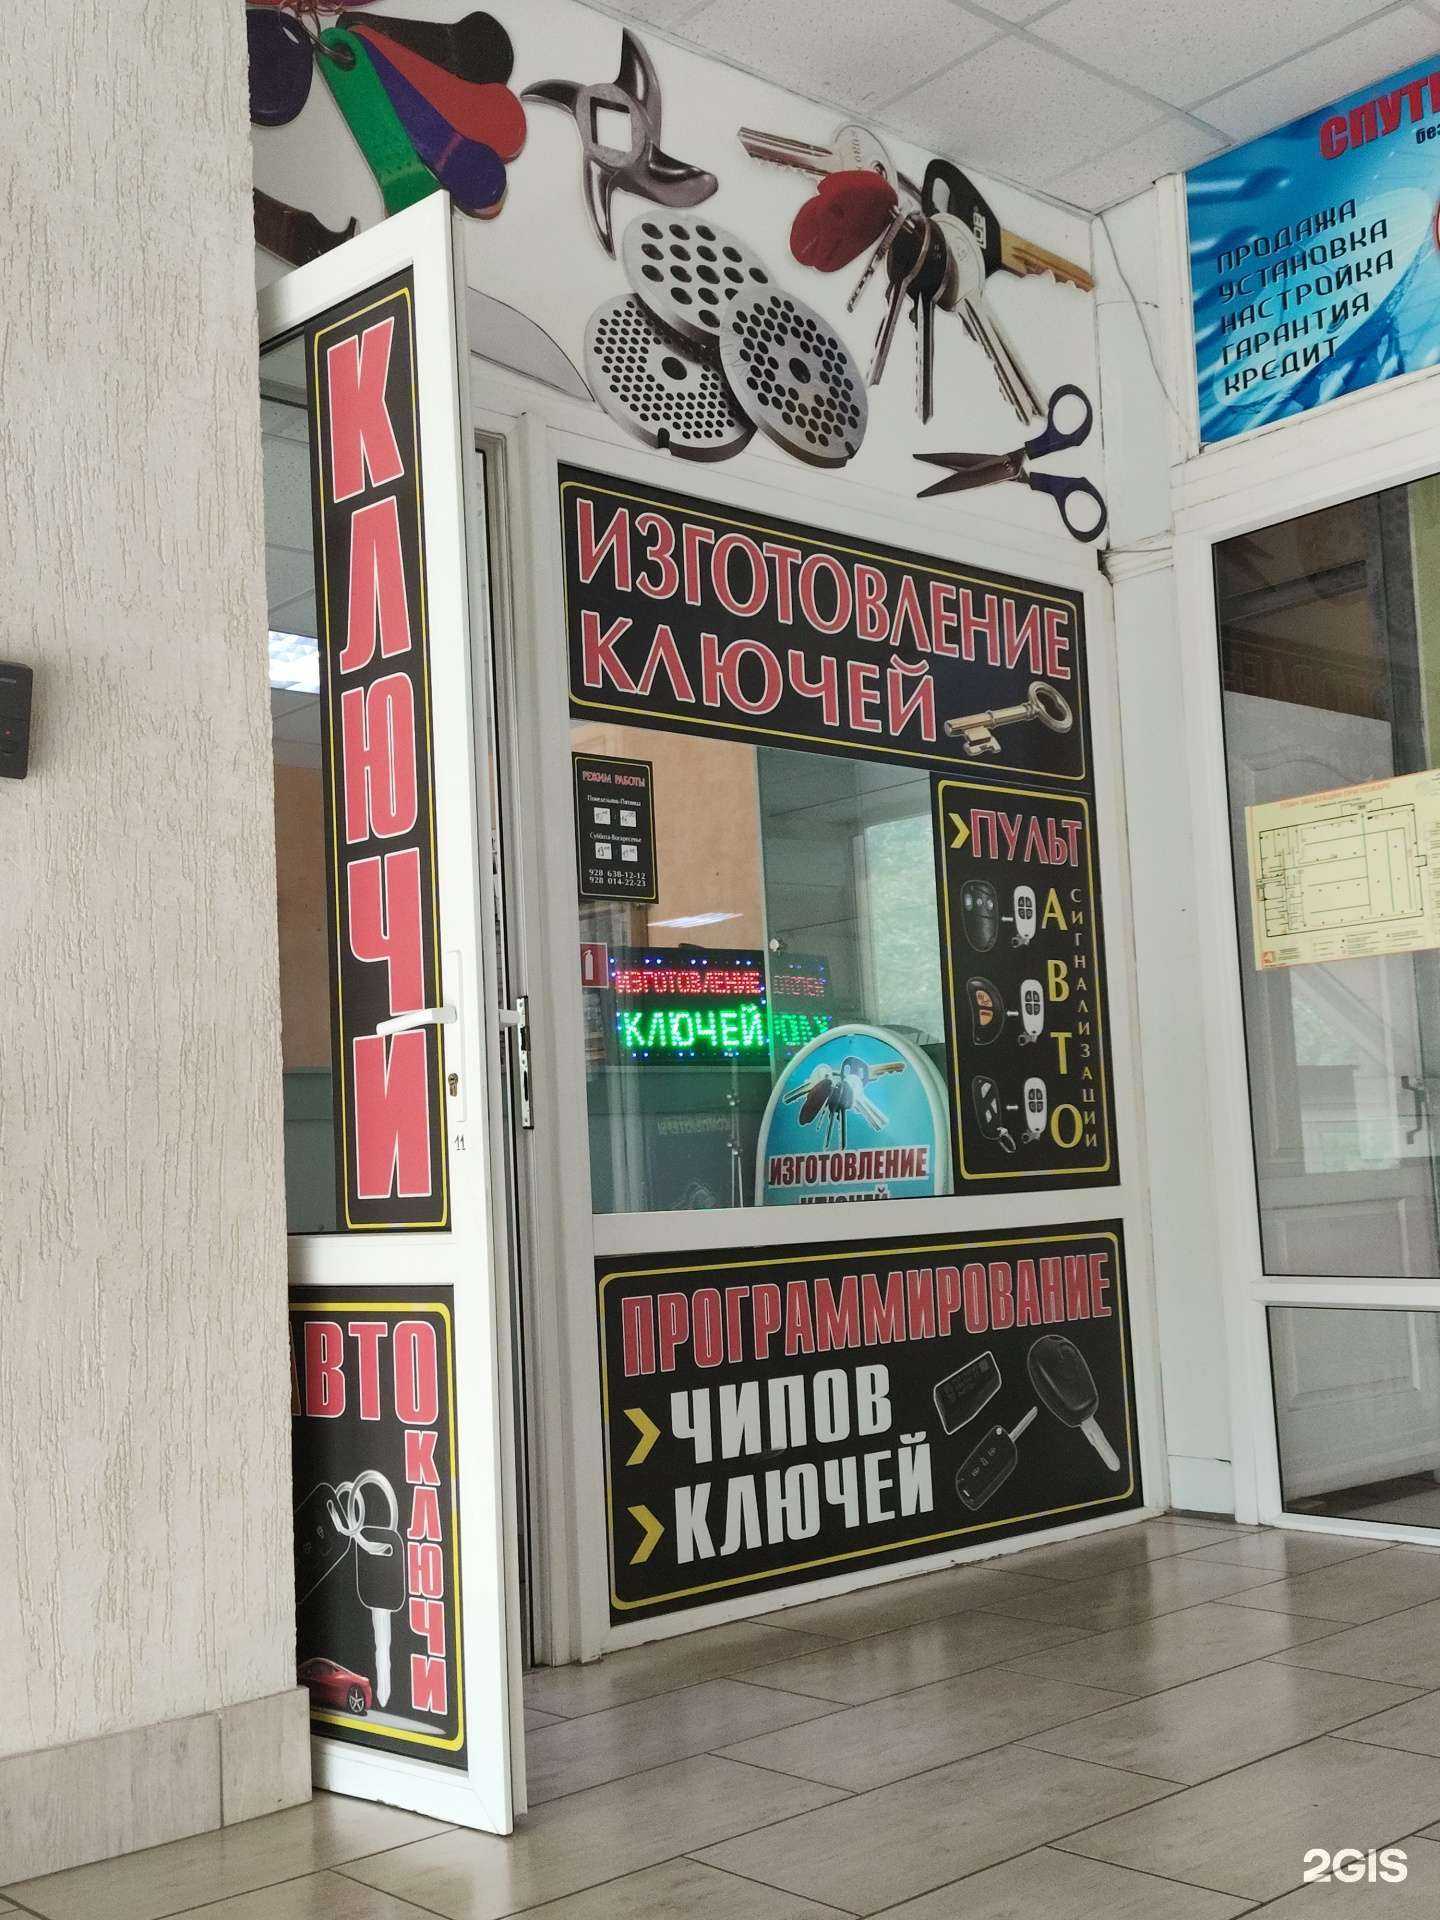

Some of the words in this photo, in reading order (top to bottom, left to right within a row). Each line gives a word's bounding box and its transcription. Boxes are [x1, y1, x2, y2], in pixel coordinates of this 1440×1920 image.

[1416, 124, 1440, 144] бе
[1217, 199, 1357, 274] ПРОДАЖА
[1219, 219, 1388, 304] УСТАНОВКА
[1221, 249, 1394, 334] НАСТРОЙКА
[1222, 292, 1370, 365] ГАРАНТИЯ
[1224, 336, 1340, 396] КРЕДИТ
[576, 497, 1072, 680] ИЗГОТОВЛЕНИЕ
[580, 610, 937, 743] КЛЮЧЕЙ
[327, 316, 432, 1200] КЛЮЧИ
[614, 774, 646, 787] РАБОТЫ
[970, 808, 1082, 867] ПУЛЬТ
[615, 970, 763, 994] ИЗГОТОВЛЕНИЕ
[1070, 888, 1098, 1148] СИГНАЛИЗАЦИИ
[623, 1003, 764, 1047] КЛЮЧЕЙ
[769, 1148, 928, 1186] ИЗГОТОВЛЕНИЕ
[621, 1253, 1112, 1377] ПРОГРАММИРОВАНИЕ
[670, 1363, 893, 1464] ЧИПОВ
[674, 1431, 934, 1565] КЛЮЧЕЙ
[404, 1430, 448, 1715] КЛЮЧИ
